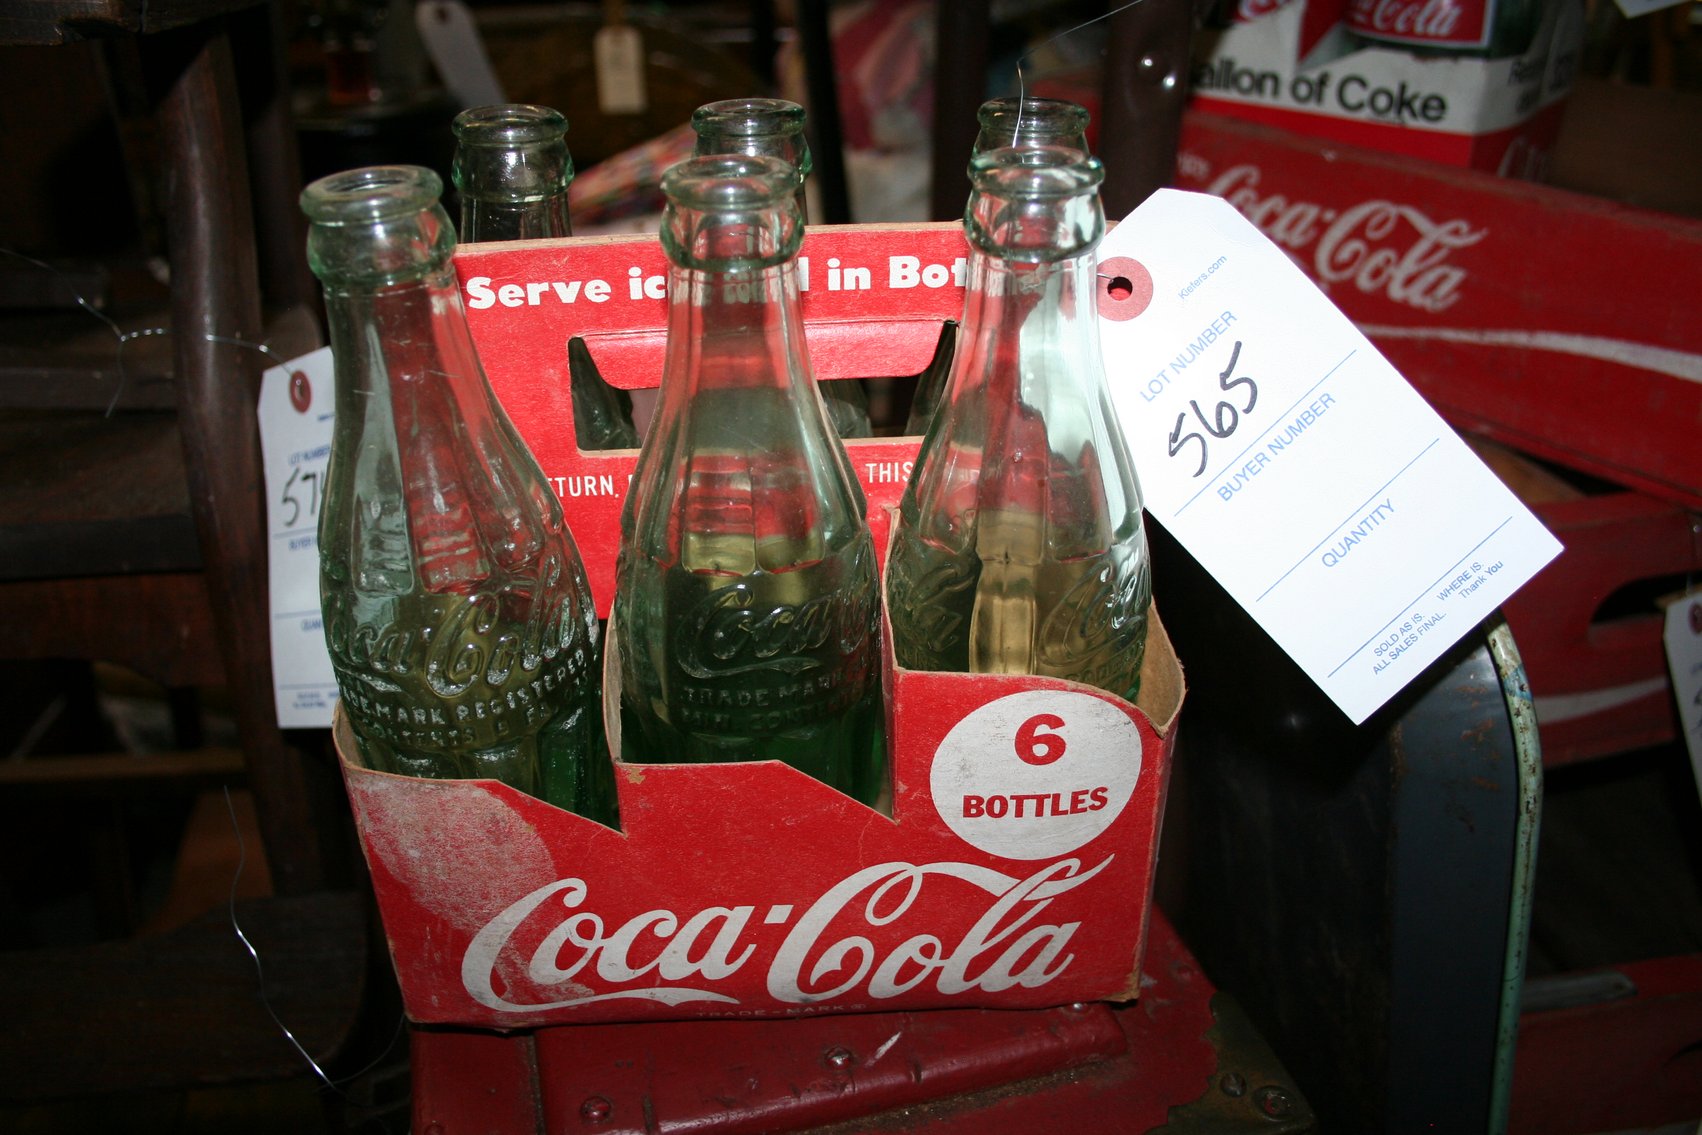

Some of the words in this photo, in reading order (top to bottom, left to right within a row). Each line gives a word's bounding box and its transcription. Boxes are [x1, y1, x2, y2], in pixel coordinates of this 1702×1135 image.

[1199, 58, 1280, 97] allon
[1290, 71, 1331, 104] of
[1337, 75, 1447, 122] Coke
[466, 276, 612, 309] Serve
[828, 258, 872, 291] in
[1178, 255, 1228, 299] Kiefers.com
[1140, 369, 1171, 402] LOT
[1169, 310, 1238, 375] NUMBER
[1168, 340, 1258, 478] 565
[866, 461, 914, 484] THIS
[1217, 451, 1271, 502] BUYER
[1267, 392, 1336, 456] NUMBER
[547, 474, 620, 499] TURN,
[1321, 498, 1395, 568] QUANTITY
[1372, 659, 1391, 675] ALL
[1388, 633, 1419, 660] SALES
[1417, 611, 1447, 636] FINAL.
[1458, 575, 1487, 599] Thank
[1485, 560, 1504, 576] You
[1373, 633, 1400, 657] SOLD
[1399, 621, 1413, 637] AS
[1436, 570, 1472, 601] WHERE
[1013, 713, 1067, 767] 6
[962, 786, 1109, 819] BOTTLES
[461, 853, 1114, 1013] Coca-Cola
